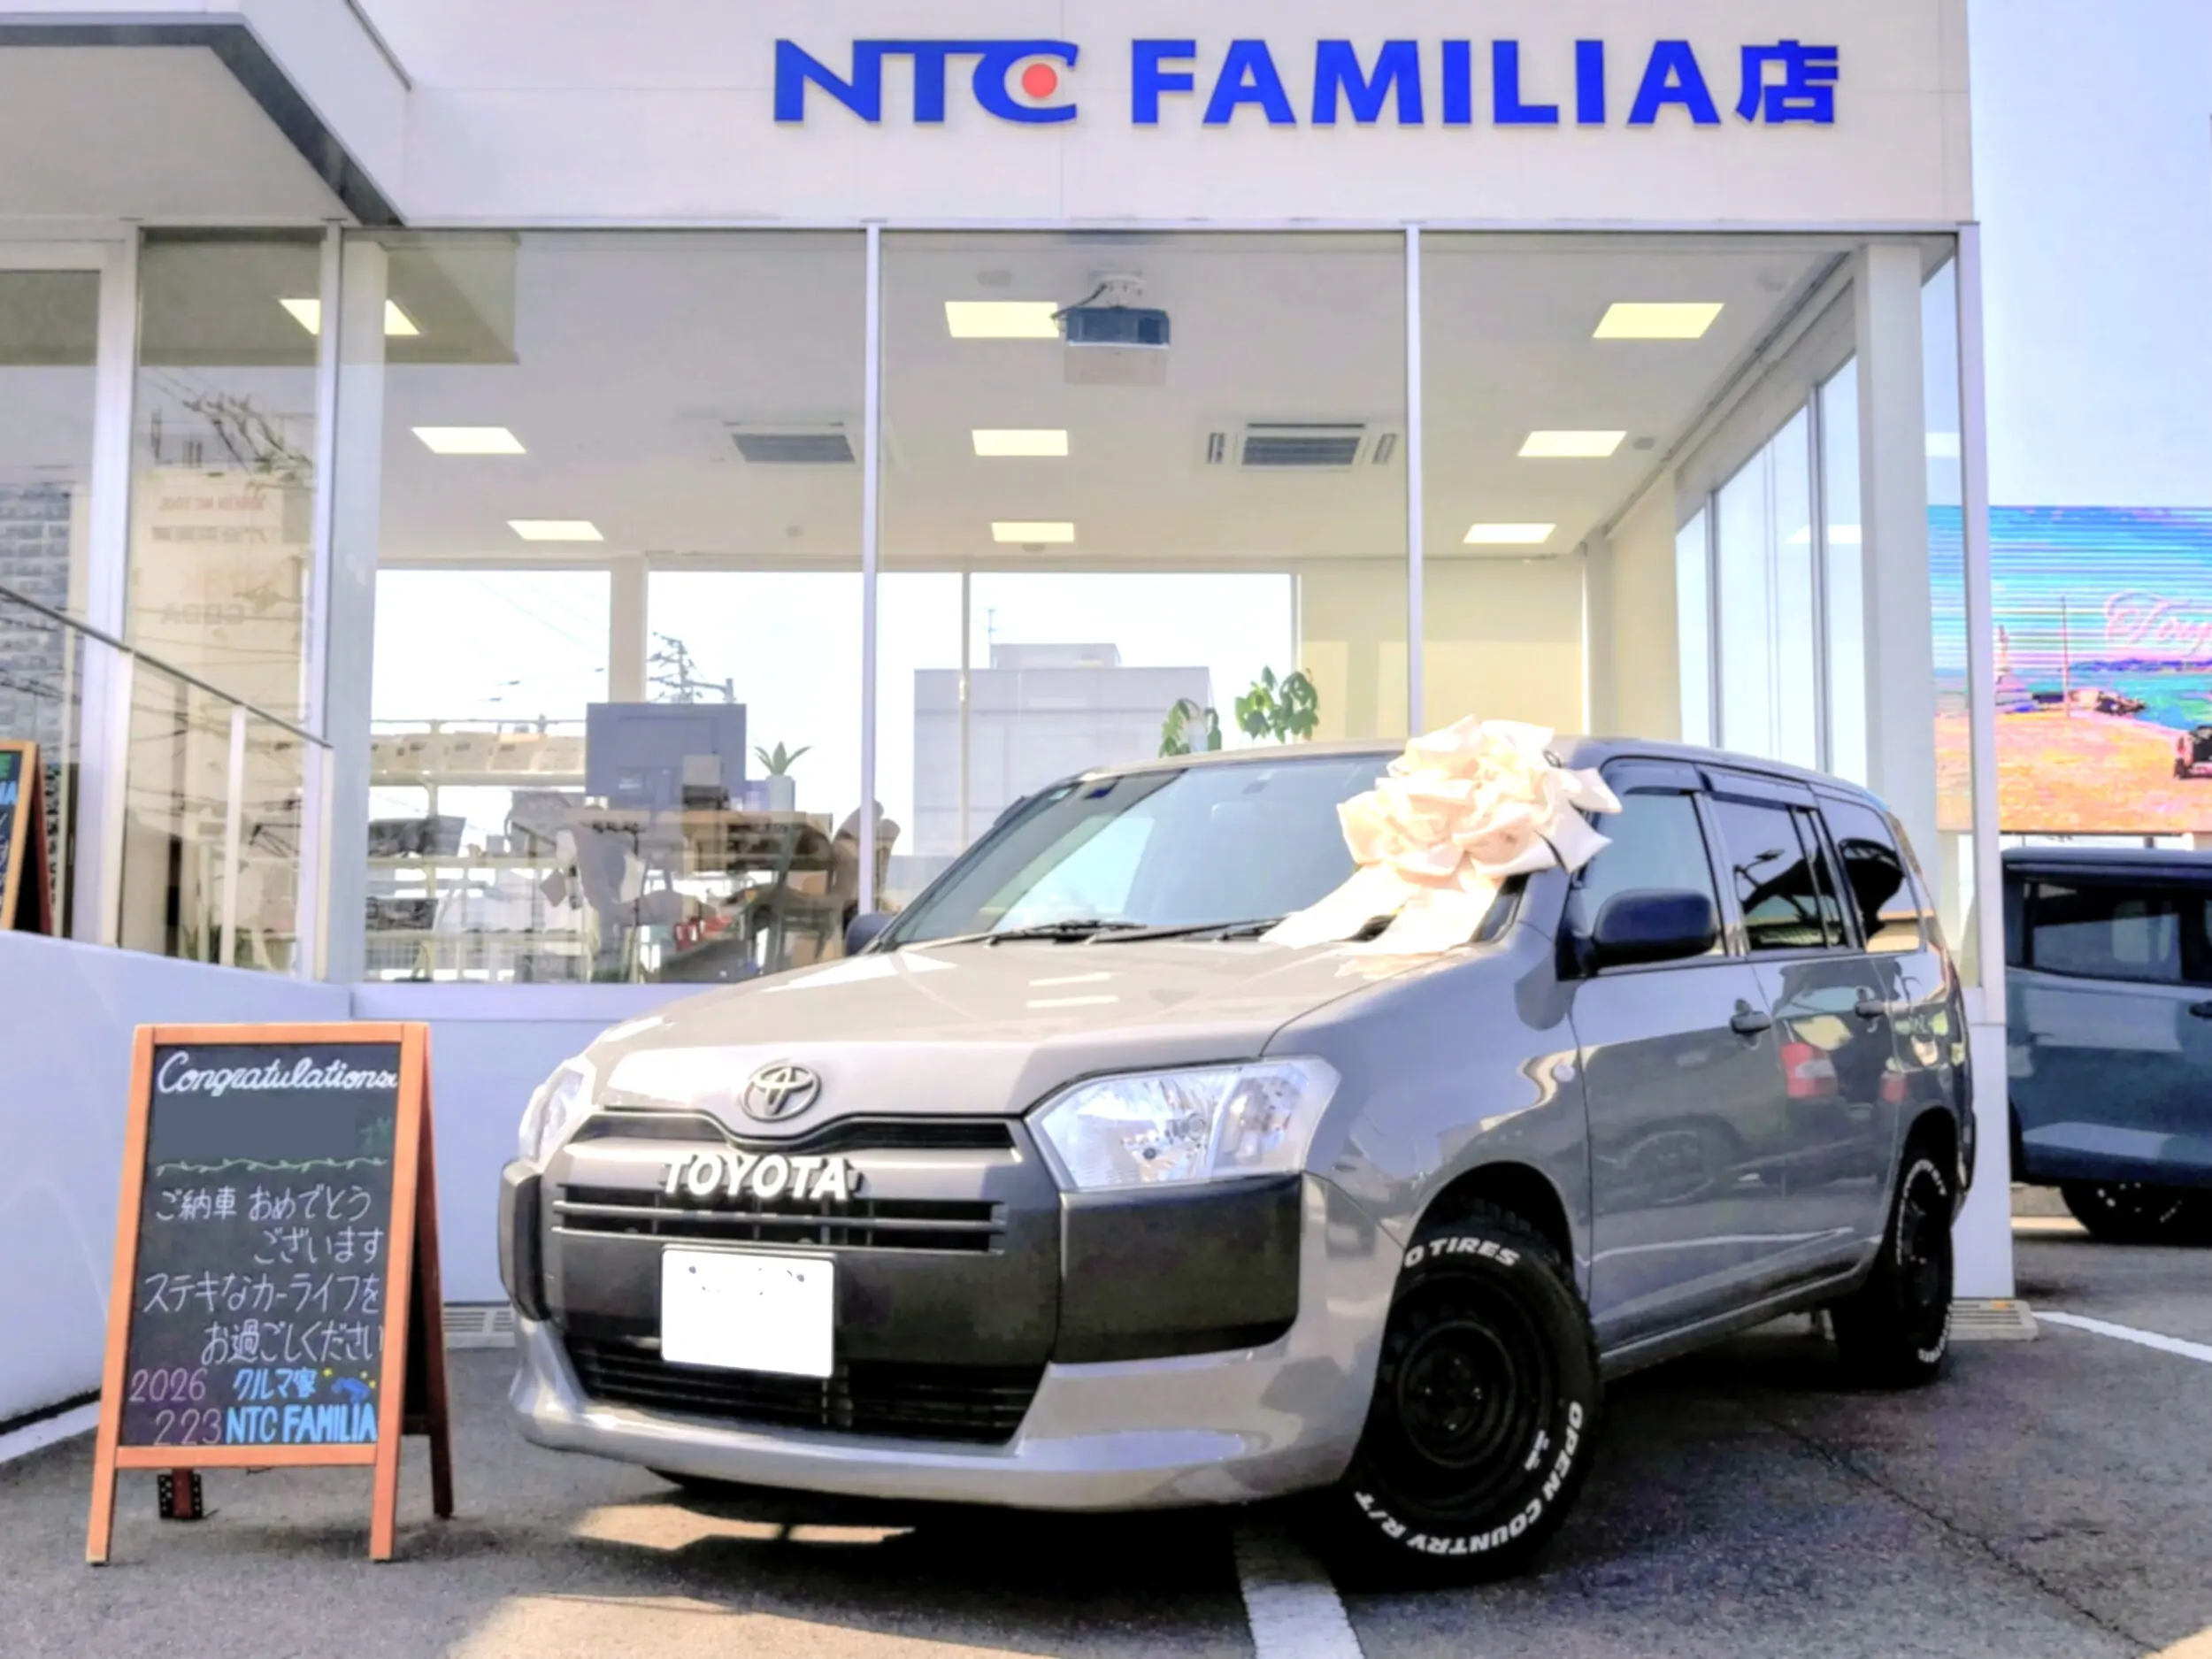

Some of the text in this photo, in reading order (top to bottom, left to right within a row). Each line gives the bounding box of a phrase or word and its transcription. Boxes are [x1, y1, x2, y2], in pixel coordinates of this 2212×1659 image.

[774, 39, 1079, 124] NTC
[664, 1154, 851, 1201] TOYOTA
[254, 1226, 384, 1263] ございます
[1429, 1236, 1520, 1267] TIRES
[142, 1271, 380, 1313] ステキなカーライフを
[201, 1318, 384, 1365] お過ごしください
[129, 1368, 208, 1402] 2026
[226, 1402, 379, 1443] NTC FAMILIA
[1543, 1402, 1583, 1502] OPEN
[1355, 1491, 1406, 1539] R/T
[1407, 1498, 1543, 1555] COUNTRY
